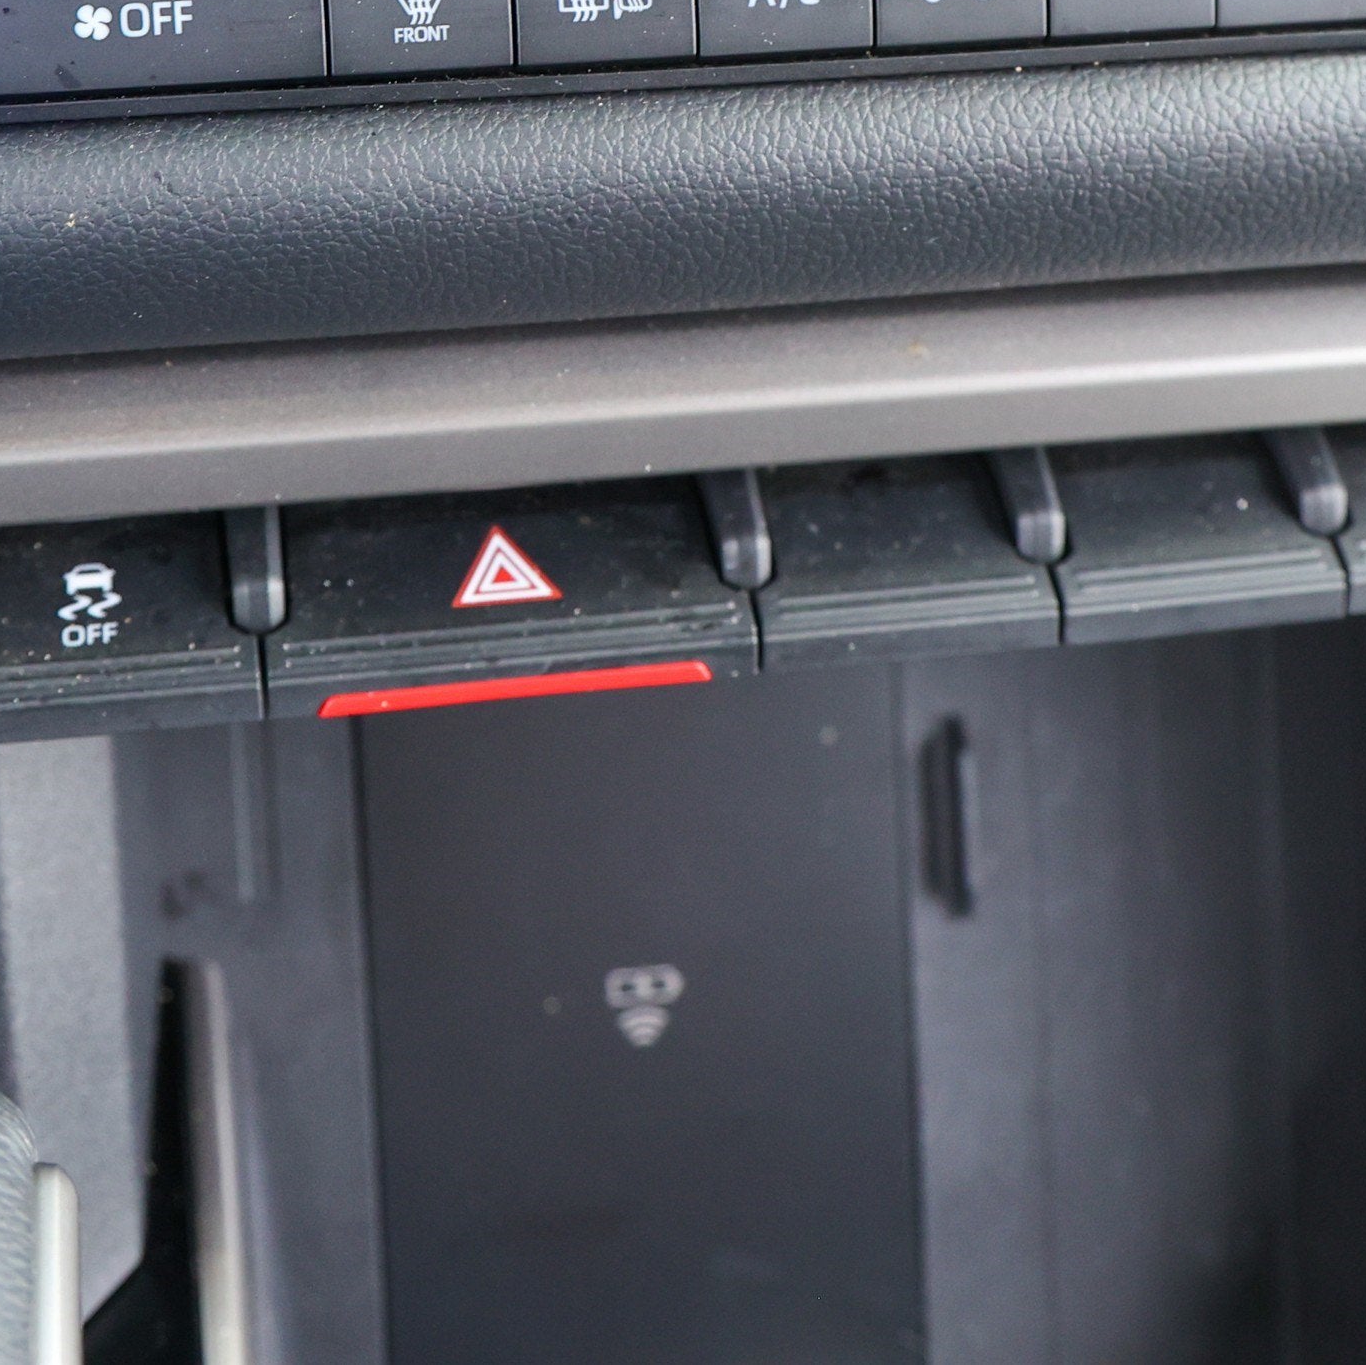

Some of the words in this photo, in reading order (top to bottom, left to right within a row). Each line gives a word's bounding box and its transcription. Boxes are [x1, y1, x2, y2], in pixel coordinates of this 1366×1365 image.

[120, 0, 193, 38] OFF
[394, 24, 450, 44] FRONT
[61, 621, 118, 648] OFF
